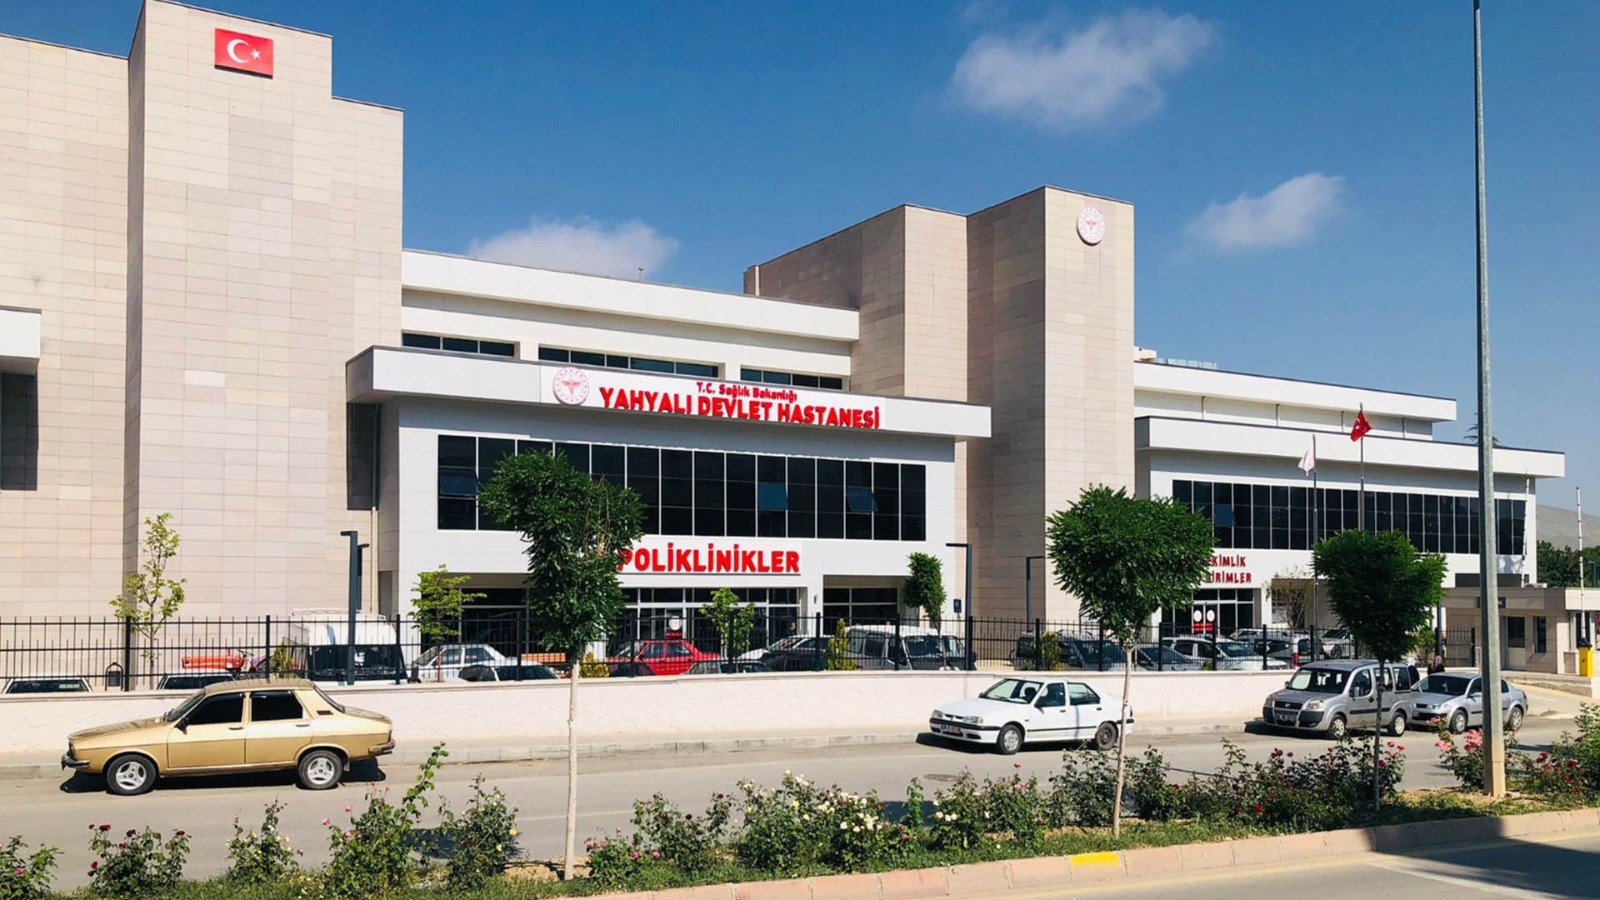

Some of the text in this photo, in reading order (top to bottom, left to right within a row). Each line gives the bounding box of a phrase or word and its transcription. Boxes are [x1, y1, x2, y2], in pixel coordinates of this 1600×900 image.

[697, 381, 798, 403] T.C. Sağlık Bakanlığı
[599, 387, 880, 429] YAHYALI DEVLET HASTANESİ
[617, 542, 800, 573] POLİKLİNİKLER
